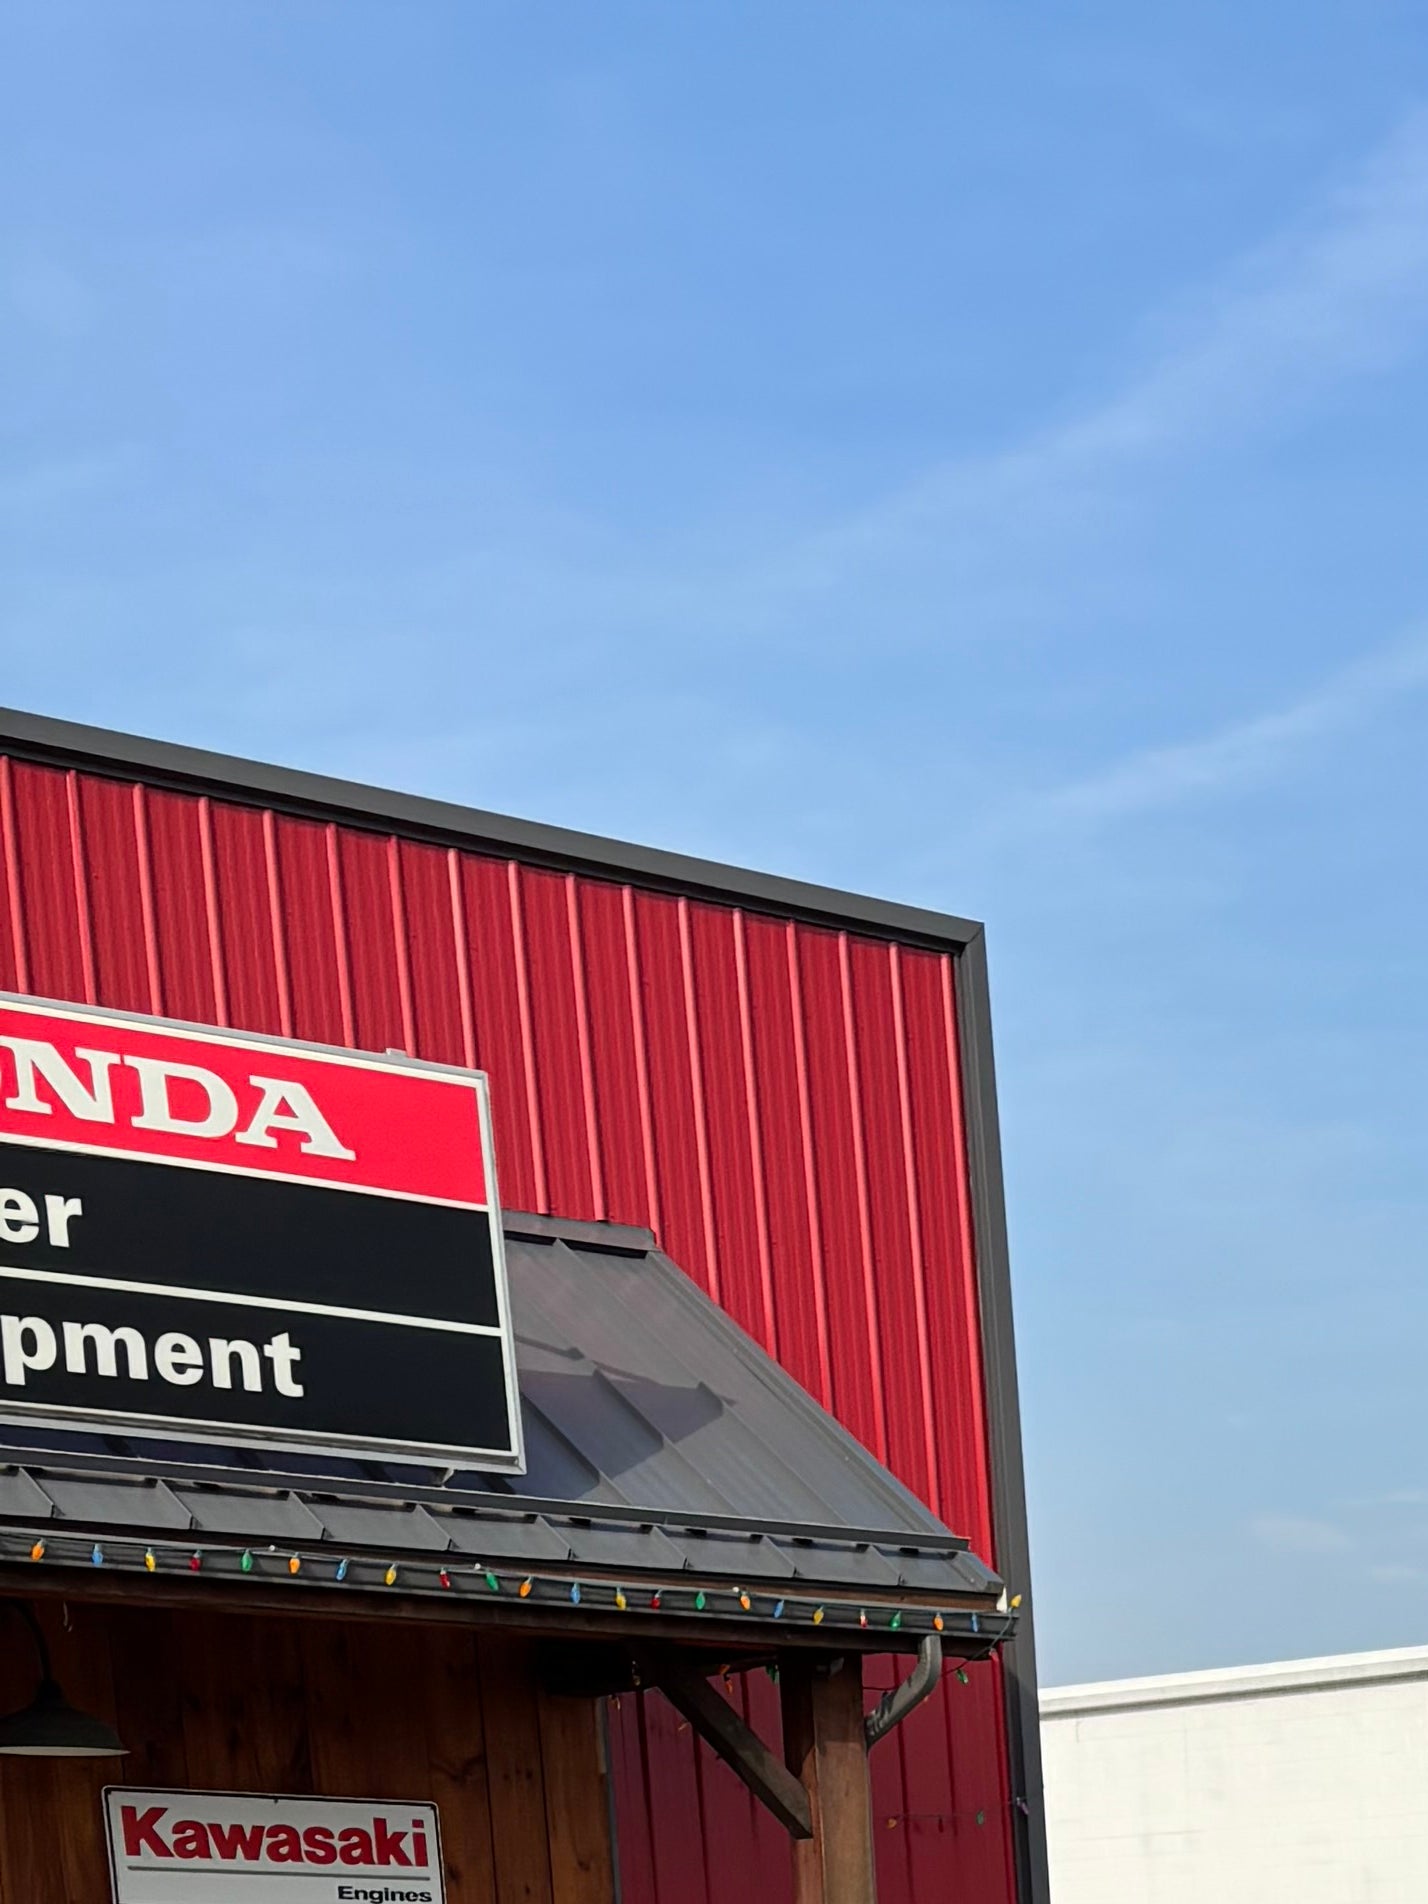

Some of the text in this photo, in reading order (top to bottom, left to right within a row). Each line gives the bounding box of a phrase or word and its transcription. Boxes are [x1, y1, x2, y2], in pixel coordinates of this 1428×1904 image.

[0, 1036, 356, 1161] NDA
[0, 1314, 304, 1397] pment
[121, 1805, 429, 1867] Kawasaki
[337, 1886, 433, 1904] Engines
